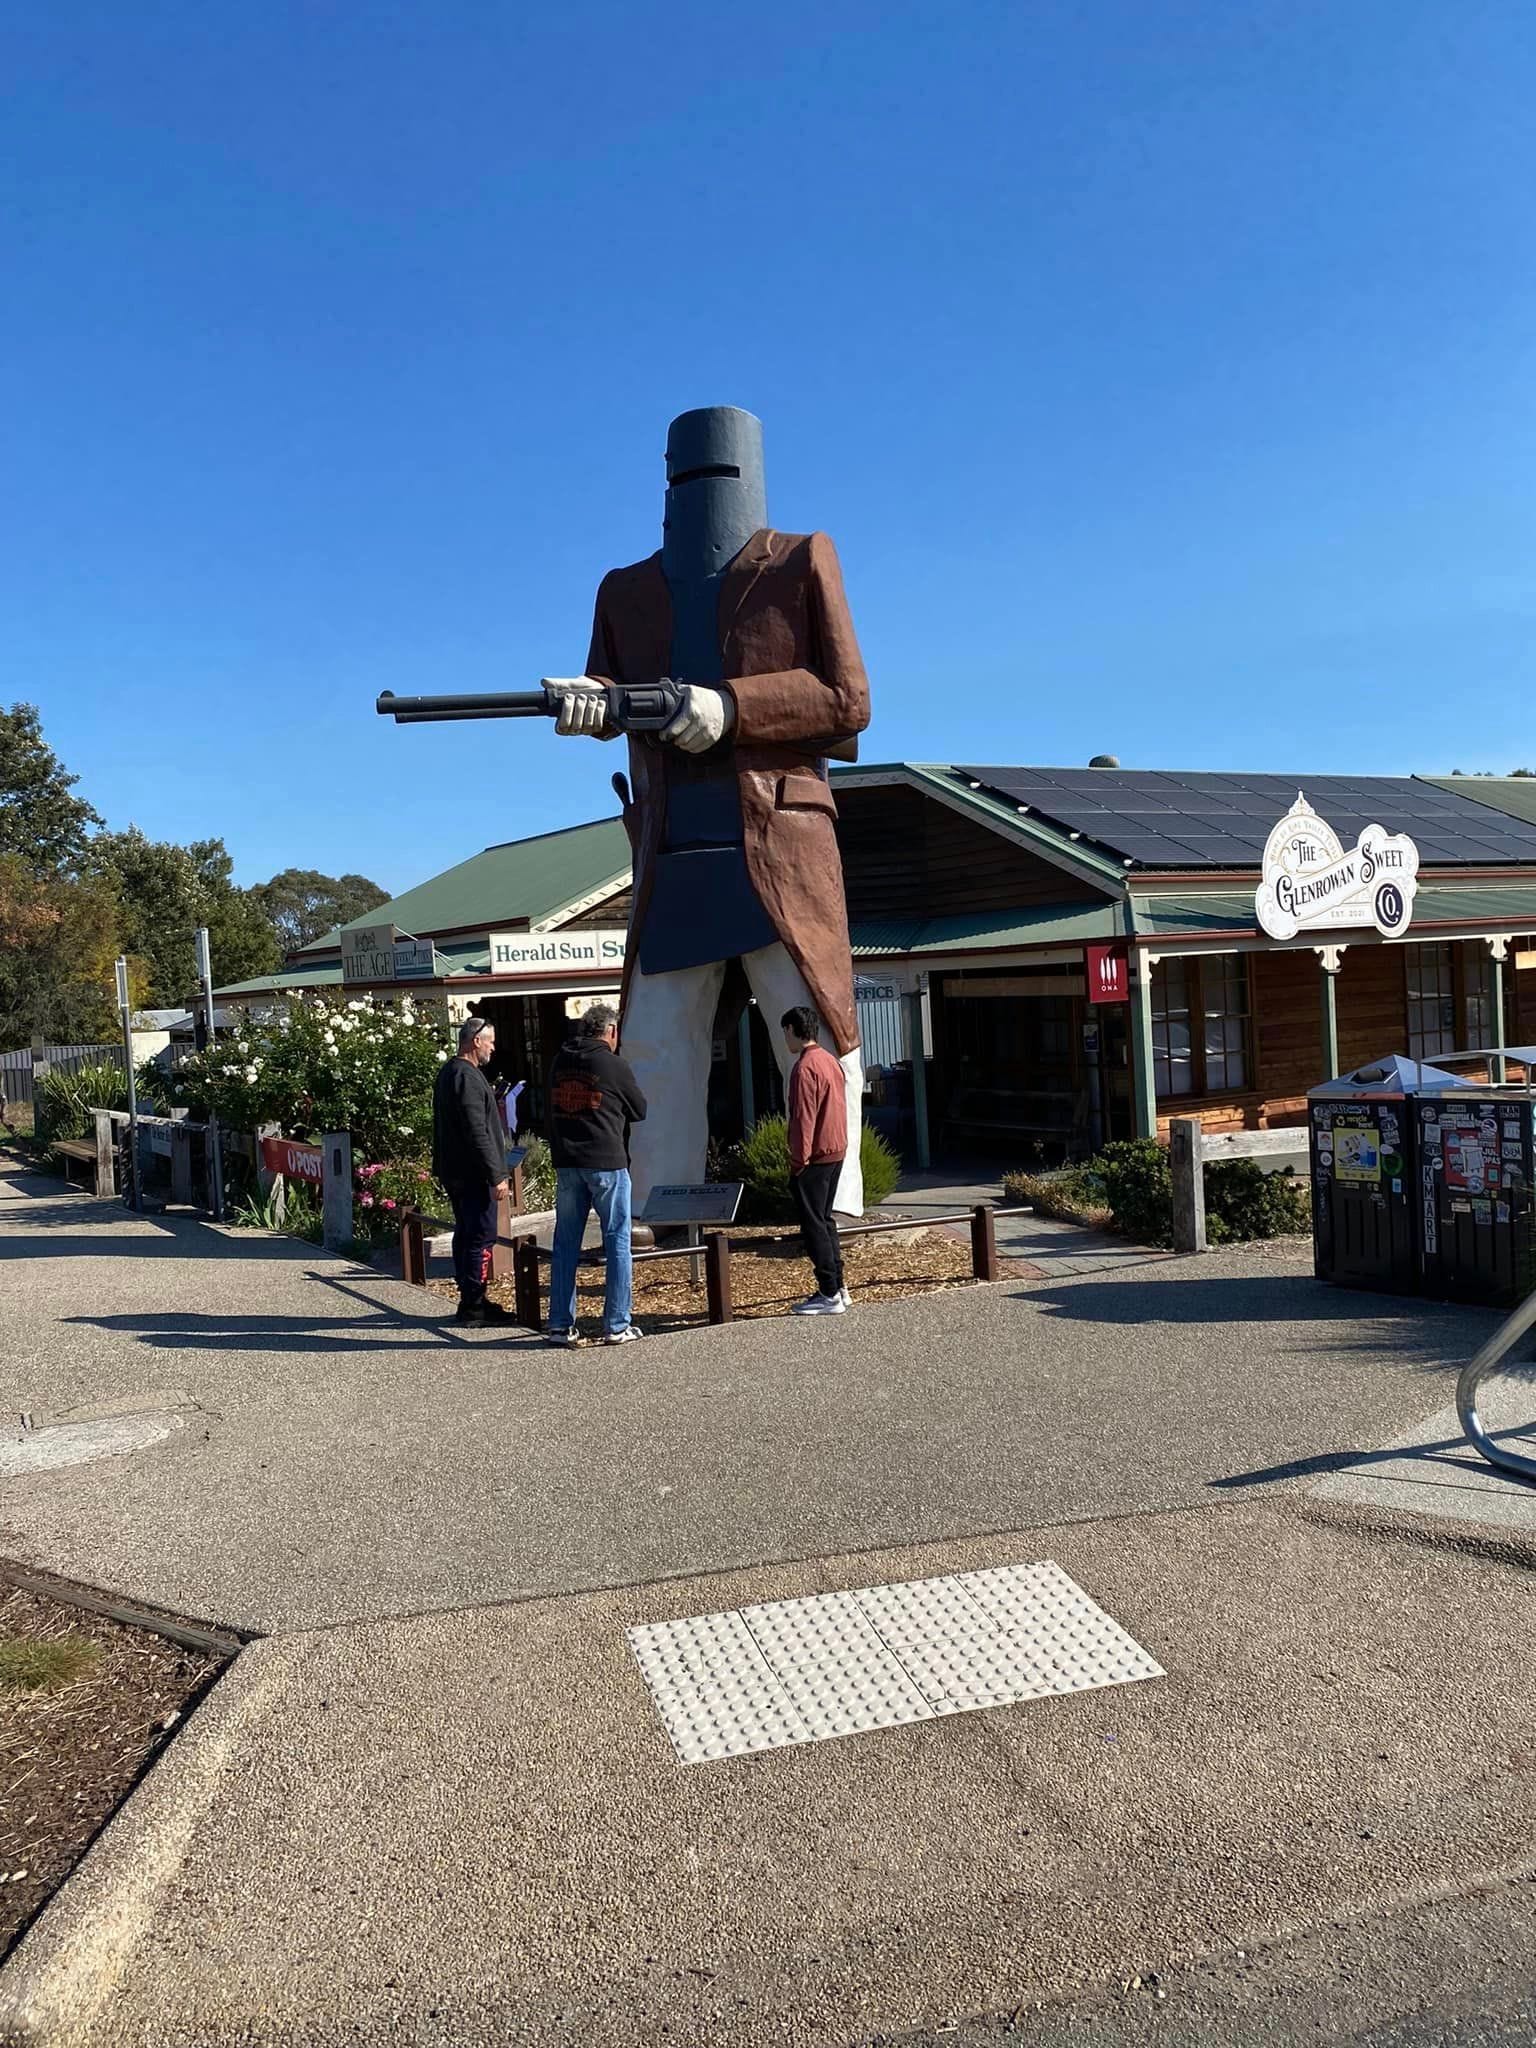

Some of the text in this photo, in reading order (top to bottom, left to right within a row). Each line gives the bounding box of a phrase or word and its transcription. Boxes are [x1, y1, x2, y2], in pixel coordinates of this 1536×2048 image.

[1291, 839, 1317, 868] THE
[1276, 841, 1403, 918] GLENROWAN SWEET
[344, 955, 367, 978] THE
[368, 952, 392, 976] AGE
[496, 943, 557, 963] Herald
[559, 942, 595, 960] Sun
[855, 986, 894, 1000] FFICE
[1101, 984, 1119, 992] ONA
[295, 1151, 322, 1178] POST
[1423, 1167, 1436, 1252] KMART
